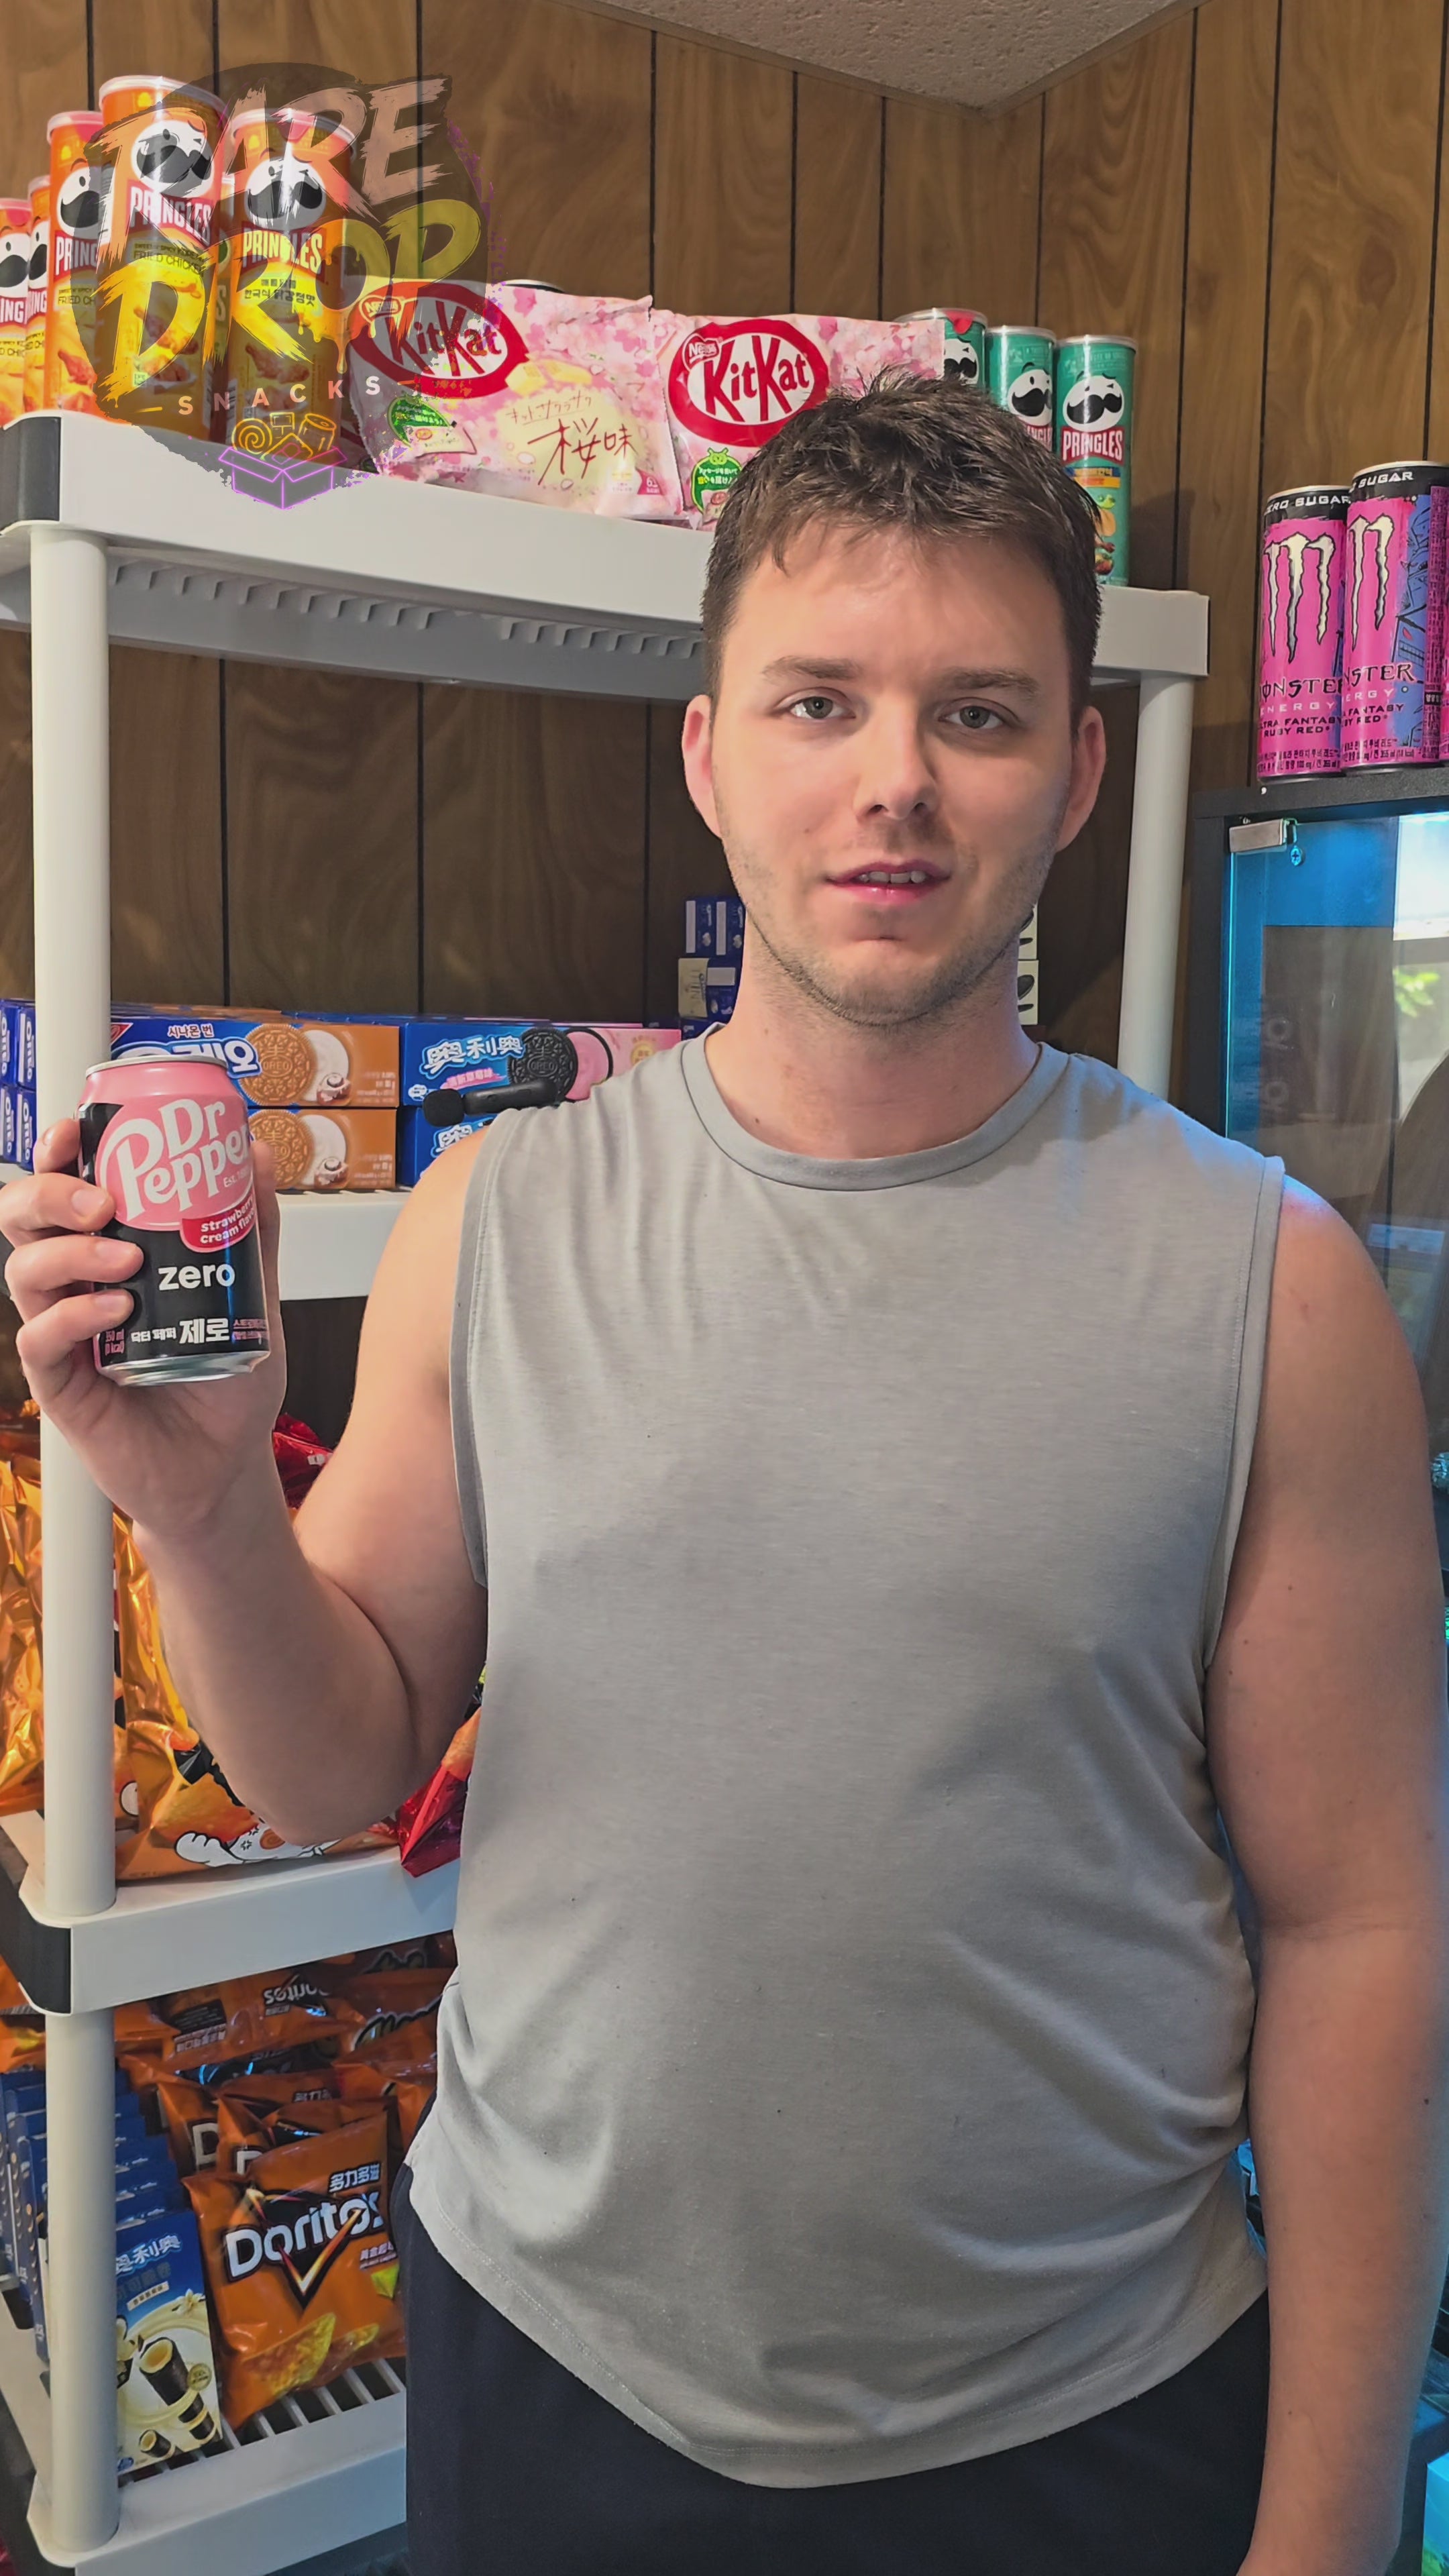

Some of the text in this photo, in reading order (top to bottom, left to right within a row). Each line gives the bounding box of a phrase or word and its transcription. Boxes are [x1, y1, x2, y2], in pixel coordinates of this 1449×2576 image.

[131, 186, 211, 246] PRINGLES
[243, 227, 323, 274] PRINGLES
[384, 300, 502, 377] KitKat
[704, 335, 810, 422] KitKat
[527, 417, 639, 486] 桜味
[1062, 429, 1123, 462] PRINGLES
[1358, 471, 1414, 488] SUGAR
[1295, 495, 1350, 507] SUGAR
[1264, 727, 1291, 737] RUBY
[168, 1023, 215, 1038] 시나몬 번
[262, 1062, 289, 1071] OREO
[423, 1035, 524, 1075] 奥利奥
[530, 1059, 555, 1070] OREO
[158, 1098, 226, 1159] Dr
[200, 1226, 239, 1244] cream
[158, 1263, 235, 1291] zero
[179, 1318, 229, 1344] 제로
[264, 1983, 331, 2005] oritos
